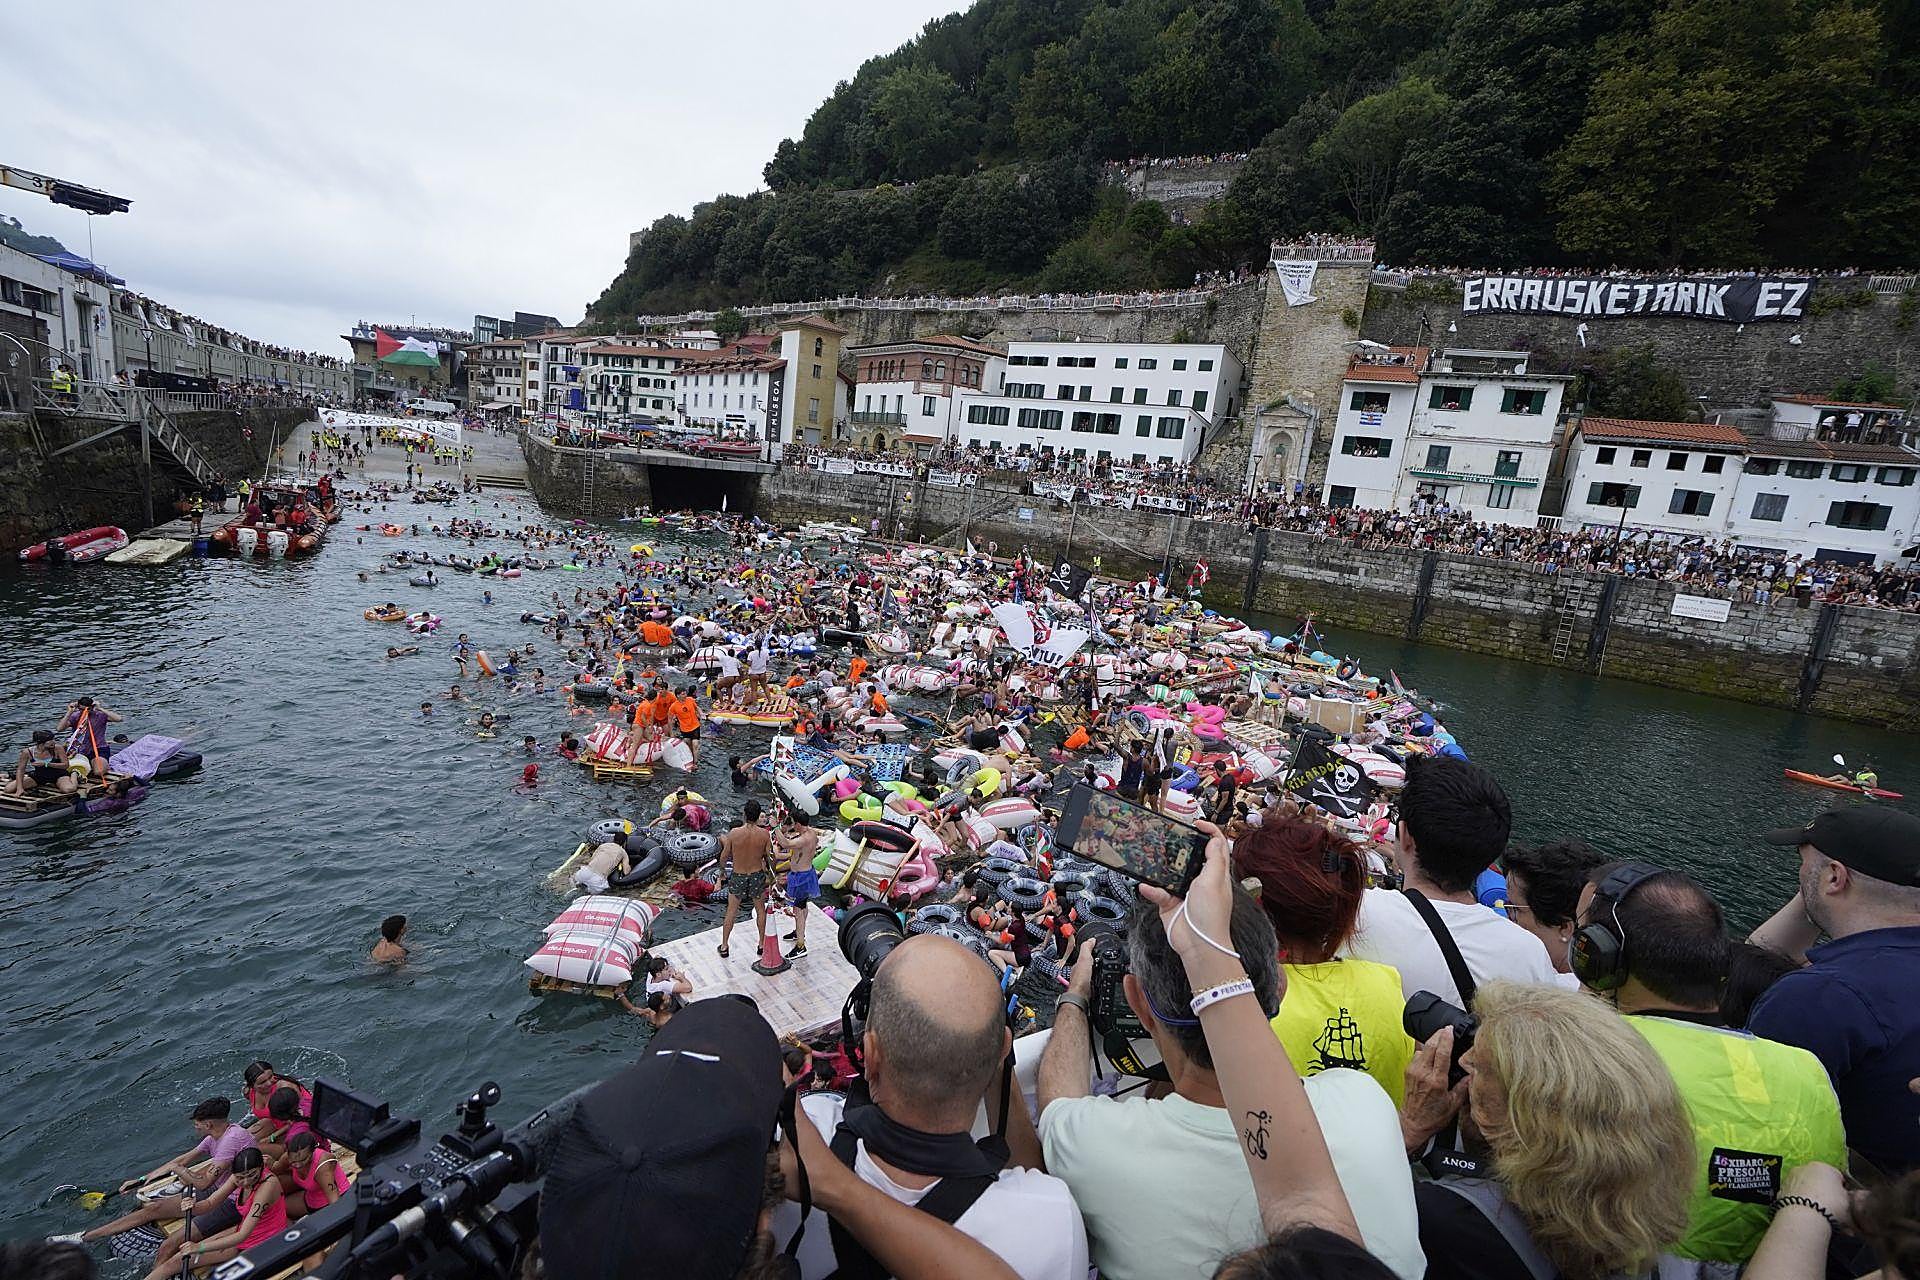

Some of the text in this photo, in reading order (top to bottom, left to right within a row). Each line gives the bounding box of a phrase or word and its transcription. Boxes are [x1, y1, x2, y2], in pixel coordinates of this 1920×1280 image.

[32, 176, 43, 188] 3
[1463, 277, 1810, 317] ERRAUSKETARIK EZ
[771, 380, 781, 426] MUSEOA
[1442, 1156, 1476, 1170] SONY
[1718, 1167, 1770, 1177] PRESOAK
